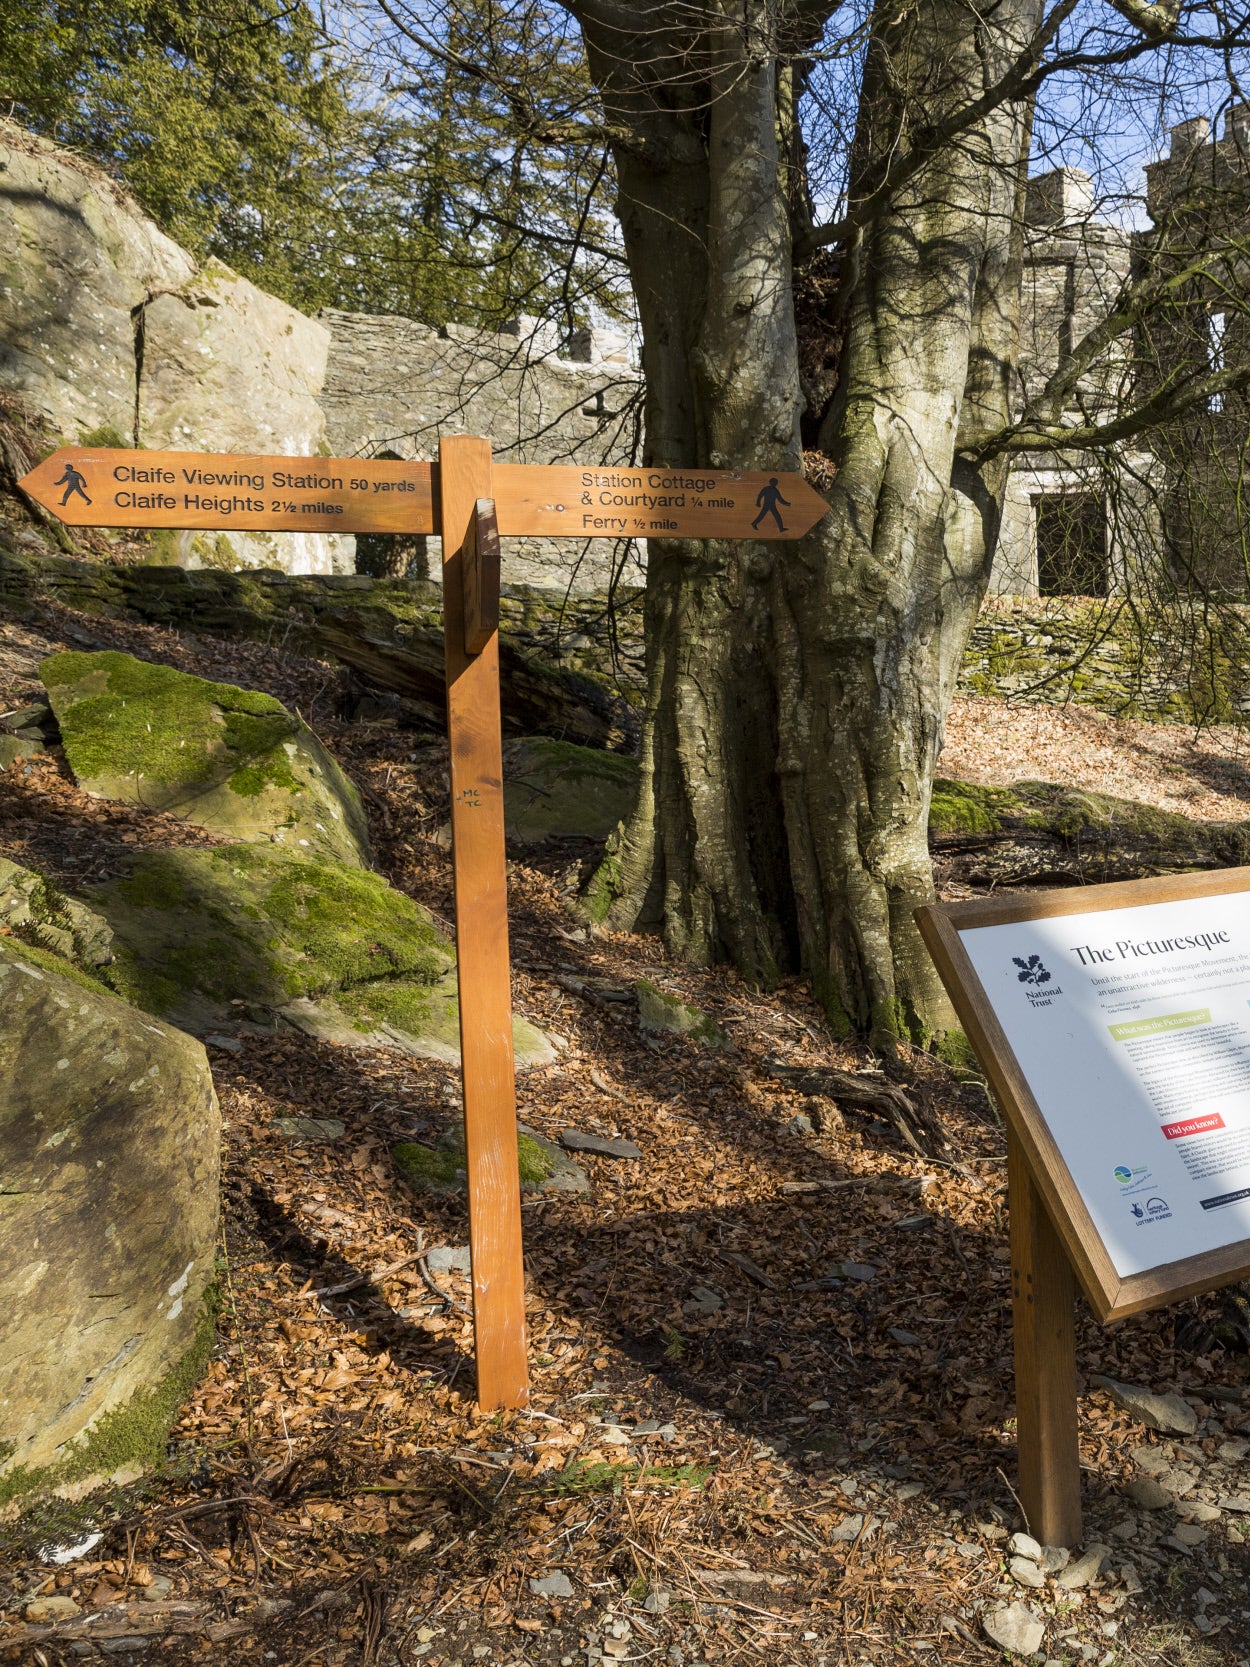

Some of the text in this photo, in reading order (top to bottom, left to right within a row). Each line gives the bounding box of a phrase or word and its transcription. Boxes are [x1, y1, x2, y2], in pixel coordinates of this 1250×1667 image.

[113, 466, 415, 493] Claife Viewing Station 50 yards
[581, 472, 716, 493] Station Cottage
[114, 492, 176, 509] Claife
[184, 494, 265, 515] Heights
[302, 502, 343, 514] miles
[581, 491, 593, 505] &
[599, 491, 685, 510] Courtyard
[707, 497, 735, 508] mile
[582, 514, 627, 532] Ferry
[650, 519, 678, 530] mile
[1070, 930, 1231, 965] The Picturesque
[1091, 977, 1111, 985] Until
[1123, 972, 1140, 980] start
[1162, 963, 1201, 973] Picturesque
[1107, 983, 1150, 994] unattractive
[1194, 970, 1222, 979] certainly
[1026, 986, 1063, 998] National
[1029, 998, 1053, 1007] Trust
[1116, 1027, 1136, 1035] What
[1151, 1021, 1164, 1029] the
[1167, 1125, 1182, 1135] Did
[1181, 1124, 1197, 1134] you
[1194, 1118, 1219, 1128] know?
